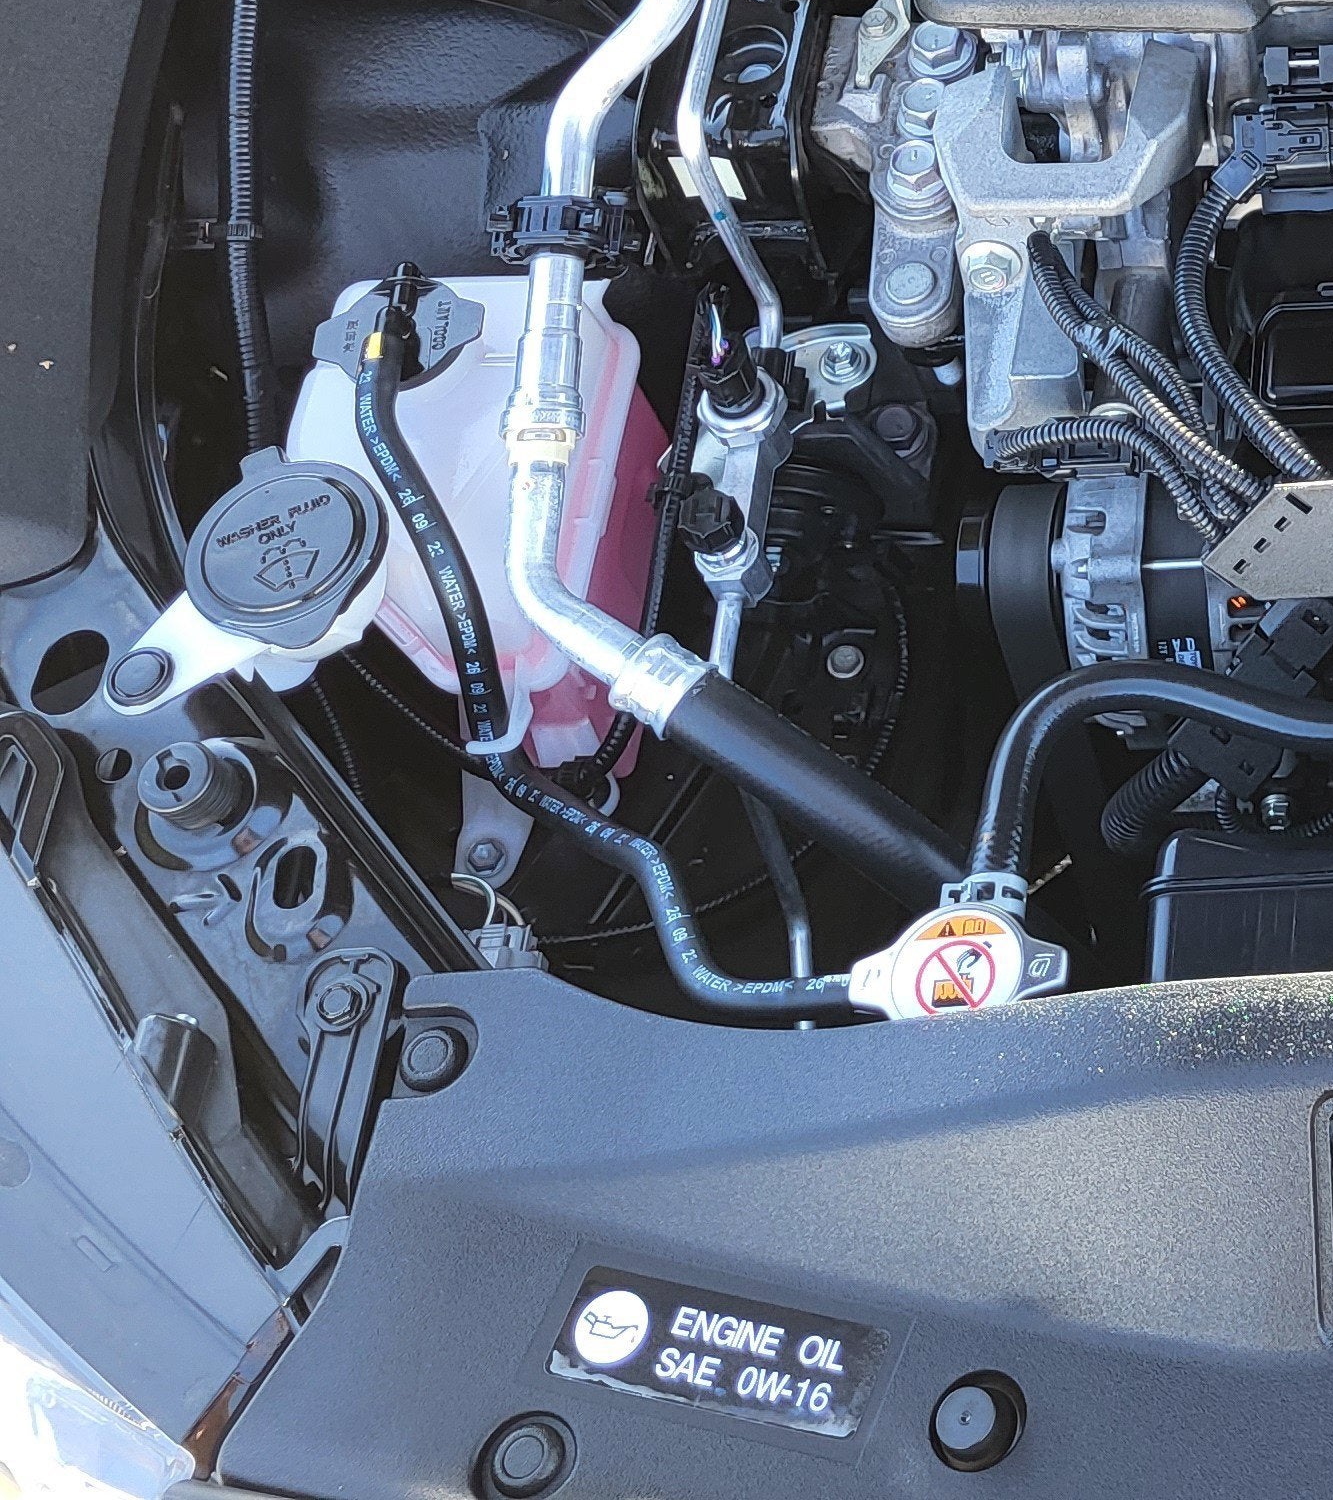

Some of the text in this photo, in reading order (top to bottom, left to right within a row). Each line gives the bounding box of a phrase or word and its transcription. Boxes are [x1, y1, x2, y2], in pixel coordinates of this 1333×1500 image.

[431, 299, 452, 351] COOLANT
[216, 493, 332, 548] WASHER FLUID
[360, 393, 378, 437] WATER
[370, 436, 402, 482] >EPDM<
[438, 565, 465, 612] WATER
[257, 520, 297, 546] ONLY
[691, 963, 733, 992] WATER
[732, 980, 795, 994] >EPDM<
[670, 1305, 845, 1373] ENGINE OIL
[655, 1347, 833, 1413] SAE 0W-16
